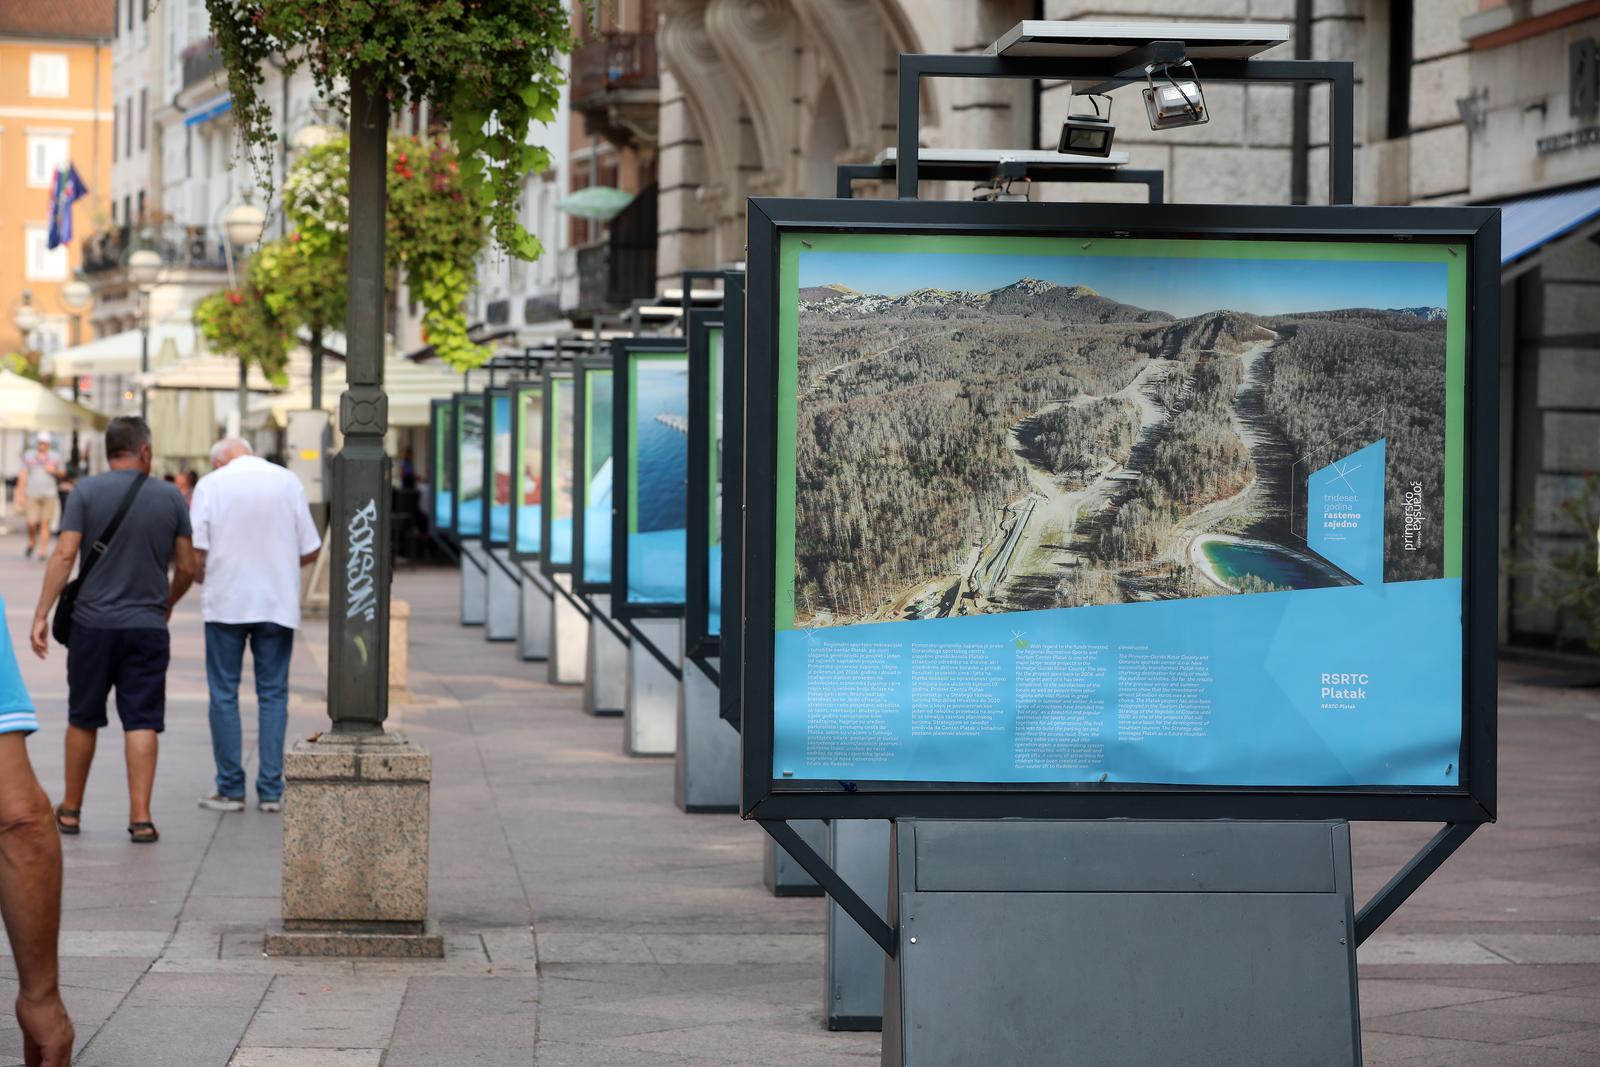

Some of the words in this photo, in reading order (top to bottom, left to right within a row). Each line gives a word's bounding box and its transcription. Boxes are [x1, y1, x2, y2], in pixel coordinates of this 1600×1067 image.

[1323, 494, 1358, 502] trideset
[1323, 503, 1353, 512] godina
[1323, 511, 1361, 519] rastemo
[1323, 520, 1358, 530] zajedno
[1401, 491, 1416, 550] primorsko
[1321, 673, 1369, 685] RSRTC
[1321, 686, 1366, 699] Platak
